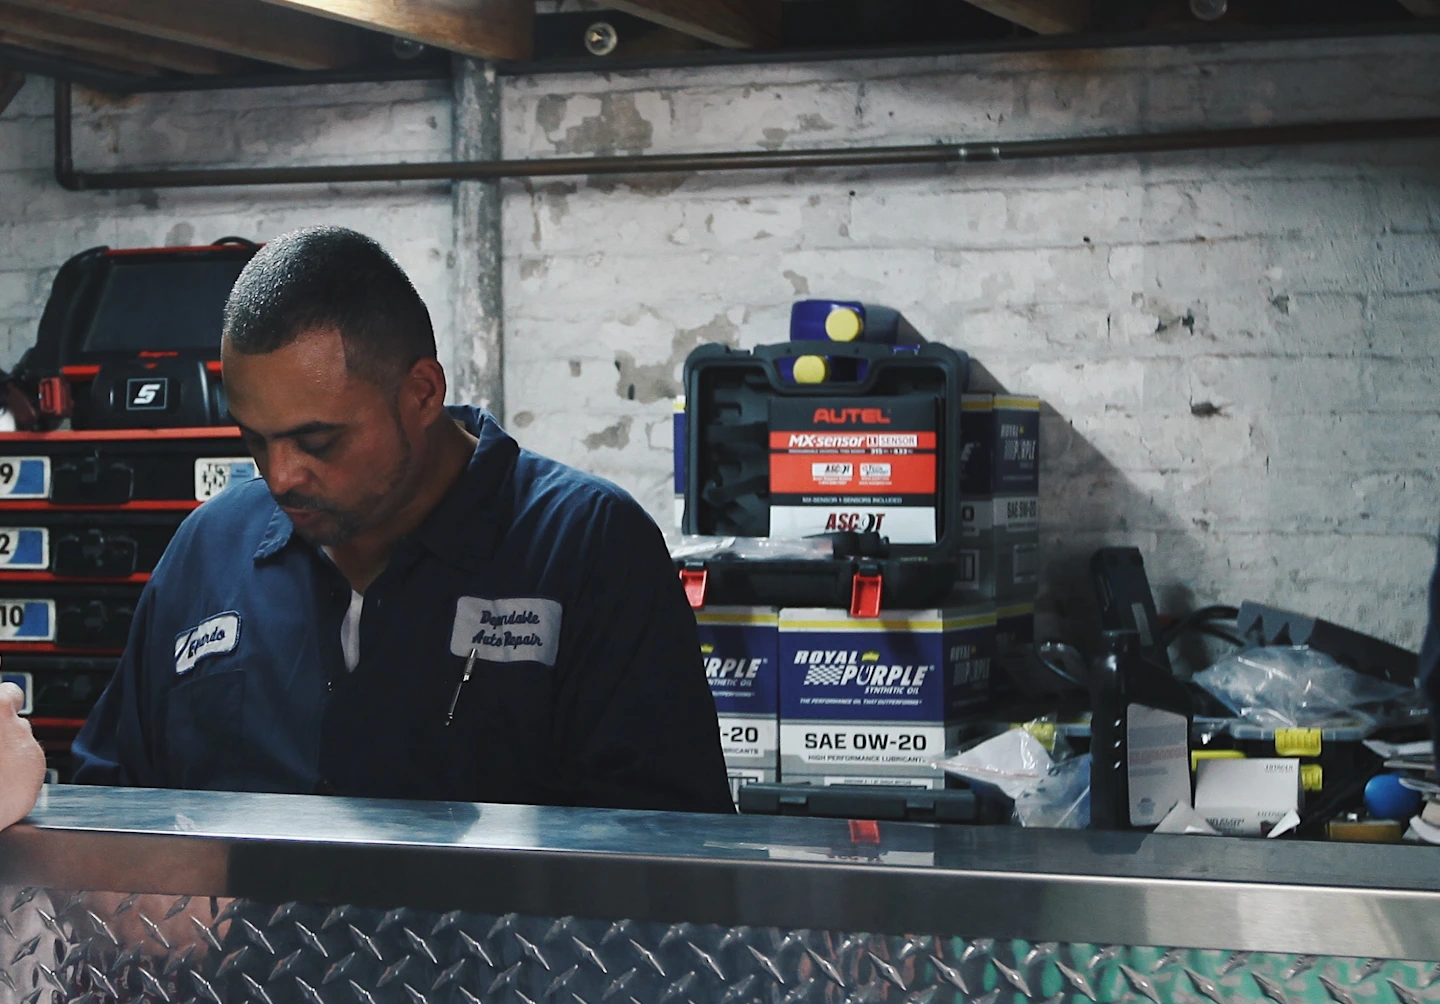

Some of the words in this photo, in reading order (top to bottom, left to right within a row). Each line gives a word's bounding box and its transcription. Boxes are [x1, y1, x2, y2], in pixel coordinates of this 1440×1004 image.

[812, 407, 891, 424] AUTEL
[880, 436, 915, 445] SENSOR
[0, 463, 14, 484] 9
[472, 629, 503, 647] Auto
[503, 631, 543, 650] Repair
[794, 650, 858, 664] ROYAL
[704, 658, 762, 679] RPLE
[840, 665, 929, 687] PURPLE
[865, 686, 904, 694] SYNTHETIC
[907, 687, 920, 695] OIL
[721, 727, 759, 743] -20
[805, 733, 847, 750] SAE
[853, 734, 927, 751] 0W-20
